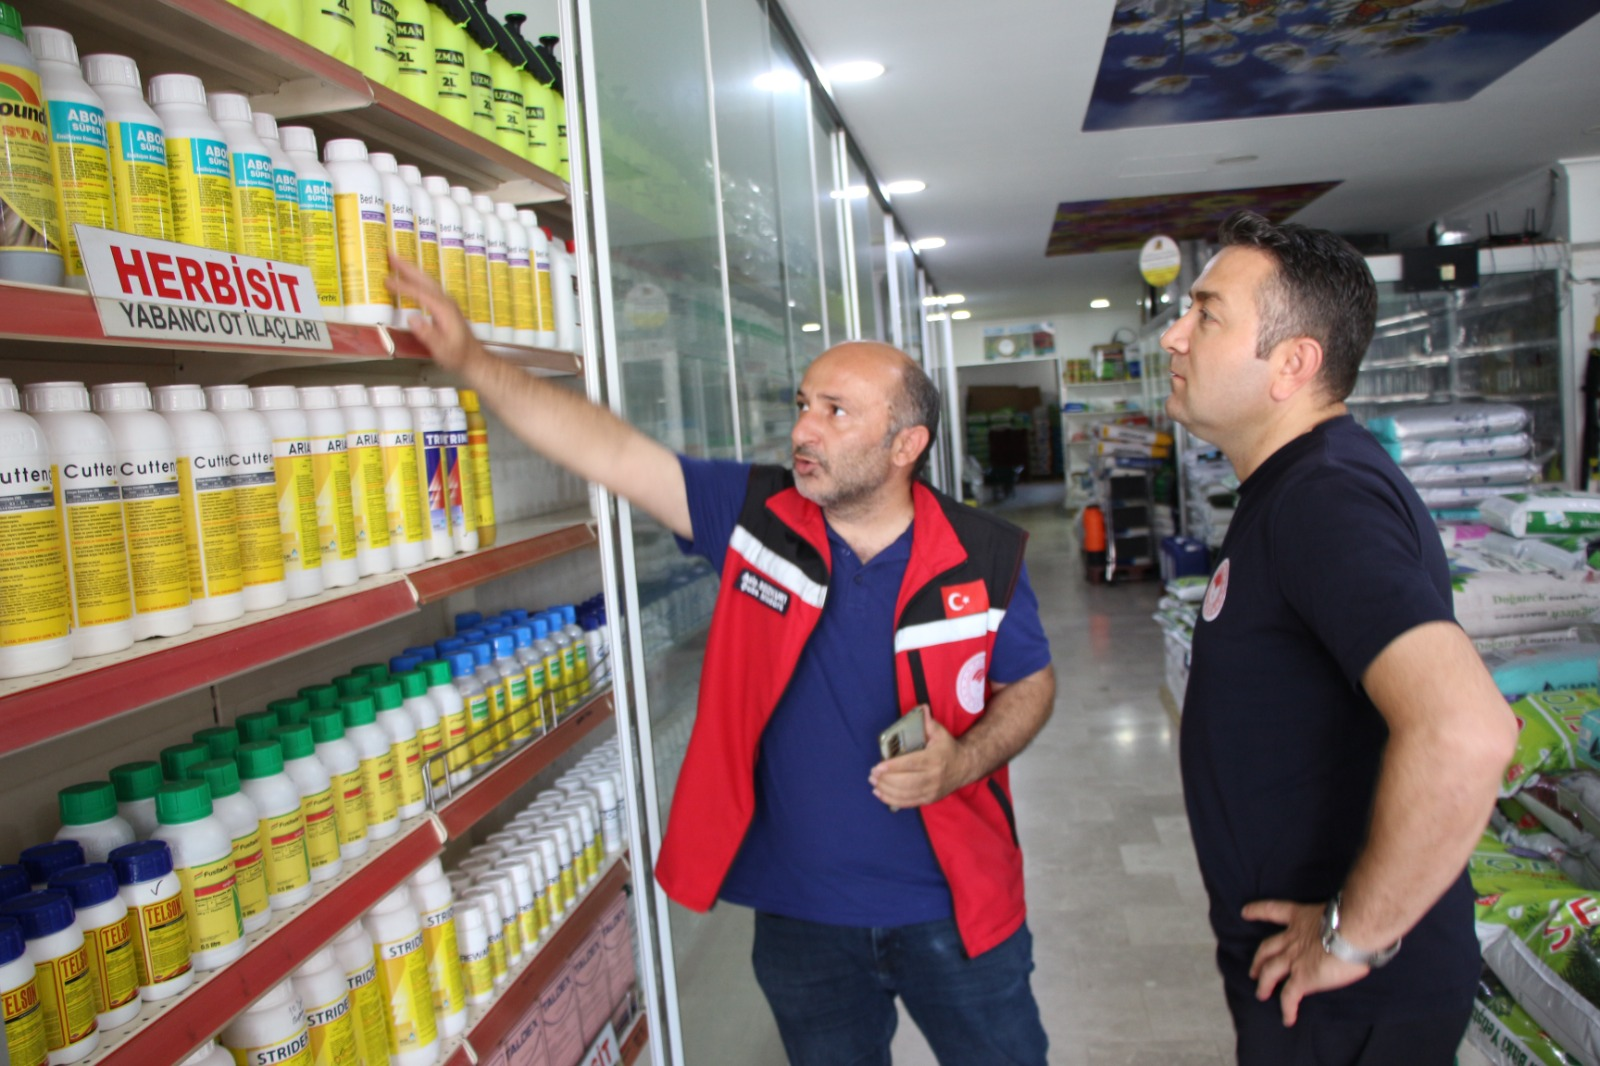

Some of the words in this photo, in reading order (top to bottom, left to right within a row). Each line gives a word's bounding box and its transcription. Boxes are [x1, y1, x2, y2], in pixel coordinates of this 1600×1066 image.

[398, 52, 414, 62] 2L
[110, 245, 301, 314] HERBİSİT
[119, 302, 216, 334] YABANCI
[218, 311, 243, 336] OT
[244, 309, 321, 344] İLAÇLARI
